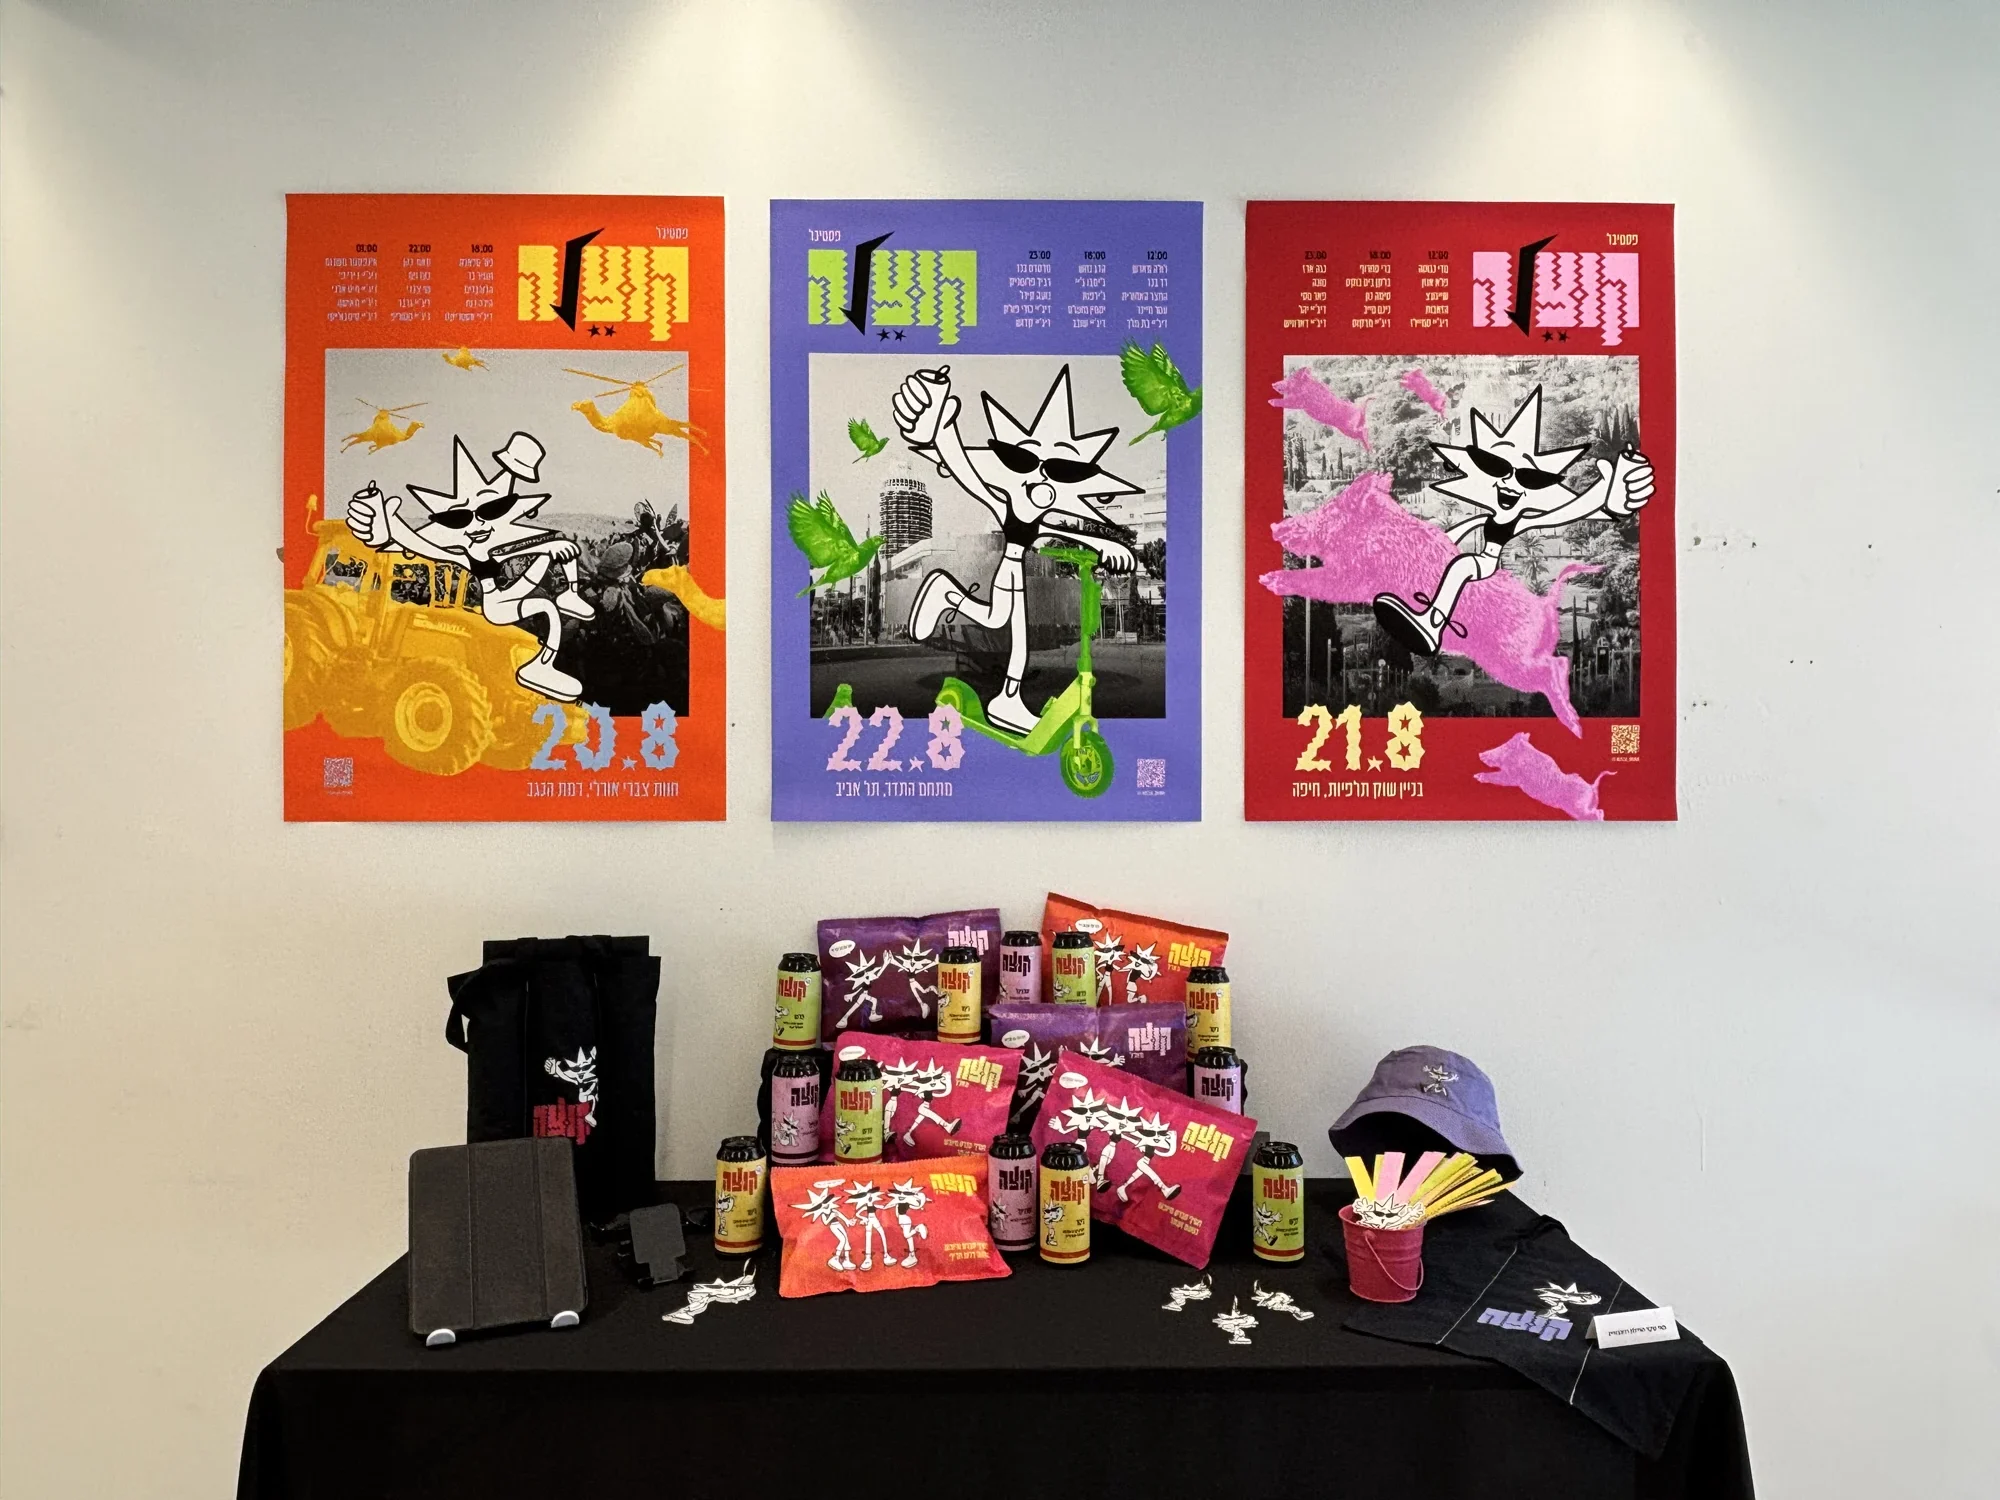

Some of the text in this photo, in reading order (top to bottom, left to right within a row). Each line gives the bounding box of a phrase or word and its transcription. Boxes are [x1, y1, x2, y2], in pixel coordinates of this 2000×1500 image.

[655, 226, 689, 240] פסטיבל
[808, 228, 842, 243] פסטיבל
[1606, 232, 1639, 246] פסטיבל
[1009, 277, 1052, 288] רביד פלוטניק
[1079, 264, 1106, 274] הדג נחש
[1359, 264, 1379, 275] סחרוף
[1122, 291, 1168, 302] החצר האחורית
[1345, 278, 1362, 289] בוקס
[1363, 305, 1376, 315] טייב
[530, 700, 680, 772] 20.8
[826, 704, 965, 772] 22.8
[1294, 700, 1426, 772] 21.8
[526, 779, 679, 798] חוות צברי אורלי, רמת הנגב
[835, 780, 953, 798] מתחם התדר, תל אביב
[1292, 779, 1424, 800] בניין שוק תלפיות, חיפה
[1001, 950, 1032, 977] קוצה
[1055, 953, 1086, 979] קוצה
[941, 967, 972, 994] קוצה
[1188, 987, 1220, 1015] קוצה
[1127, 1021, 1172, 1057] קוצה
[955, 1055, 1004, 1093] קוצה
[1201, 1073, 1235, 1102] קוצה
[840, 1086, 873, 1115] קוצה
[1181, 1120, 1235, 1163] קוצה
[722, 1166, 758, 1196] קוצה
[928, 1172, 978, 1198] קוצה
[998, 1165, 1033, 1195] קוצה
[1049, 1175, 1085, 1206] קוצה
[1263, 1174, 1298, 1205] קוצה
[1476, 1306, 1574, 1342] קוצה
